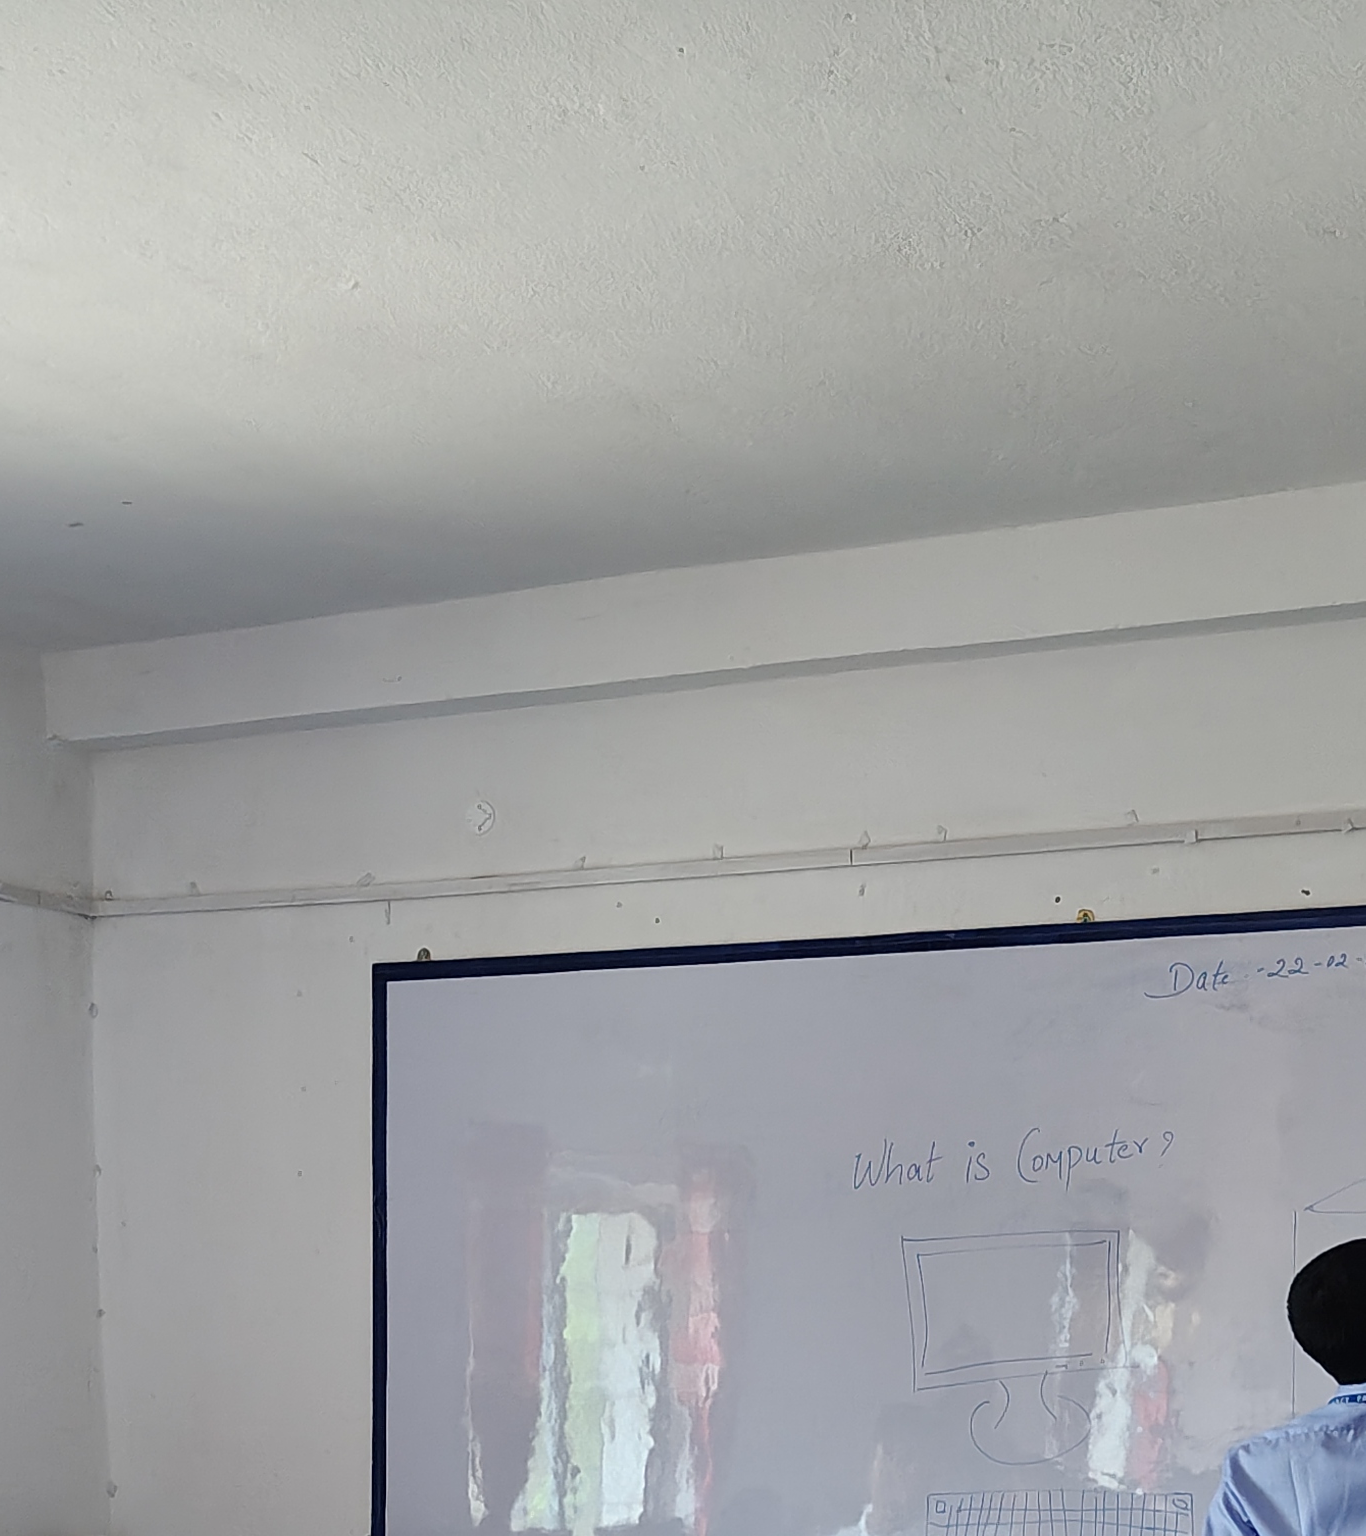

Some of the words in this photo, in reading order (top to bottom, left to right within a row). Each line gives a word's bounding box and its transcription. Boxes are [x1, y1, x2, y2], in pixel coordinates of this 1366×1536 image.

[1144, 961, 1230, 999] Date
[853, 1138, 943, 1190] What
[966, 1140, 991, 1183] is
